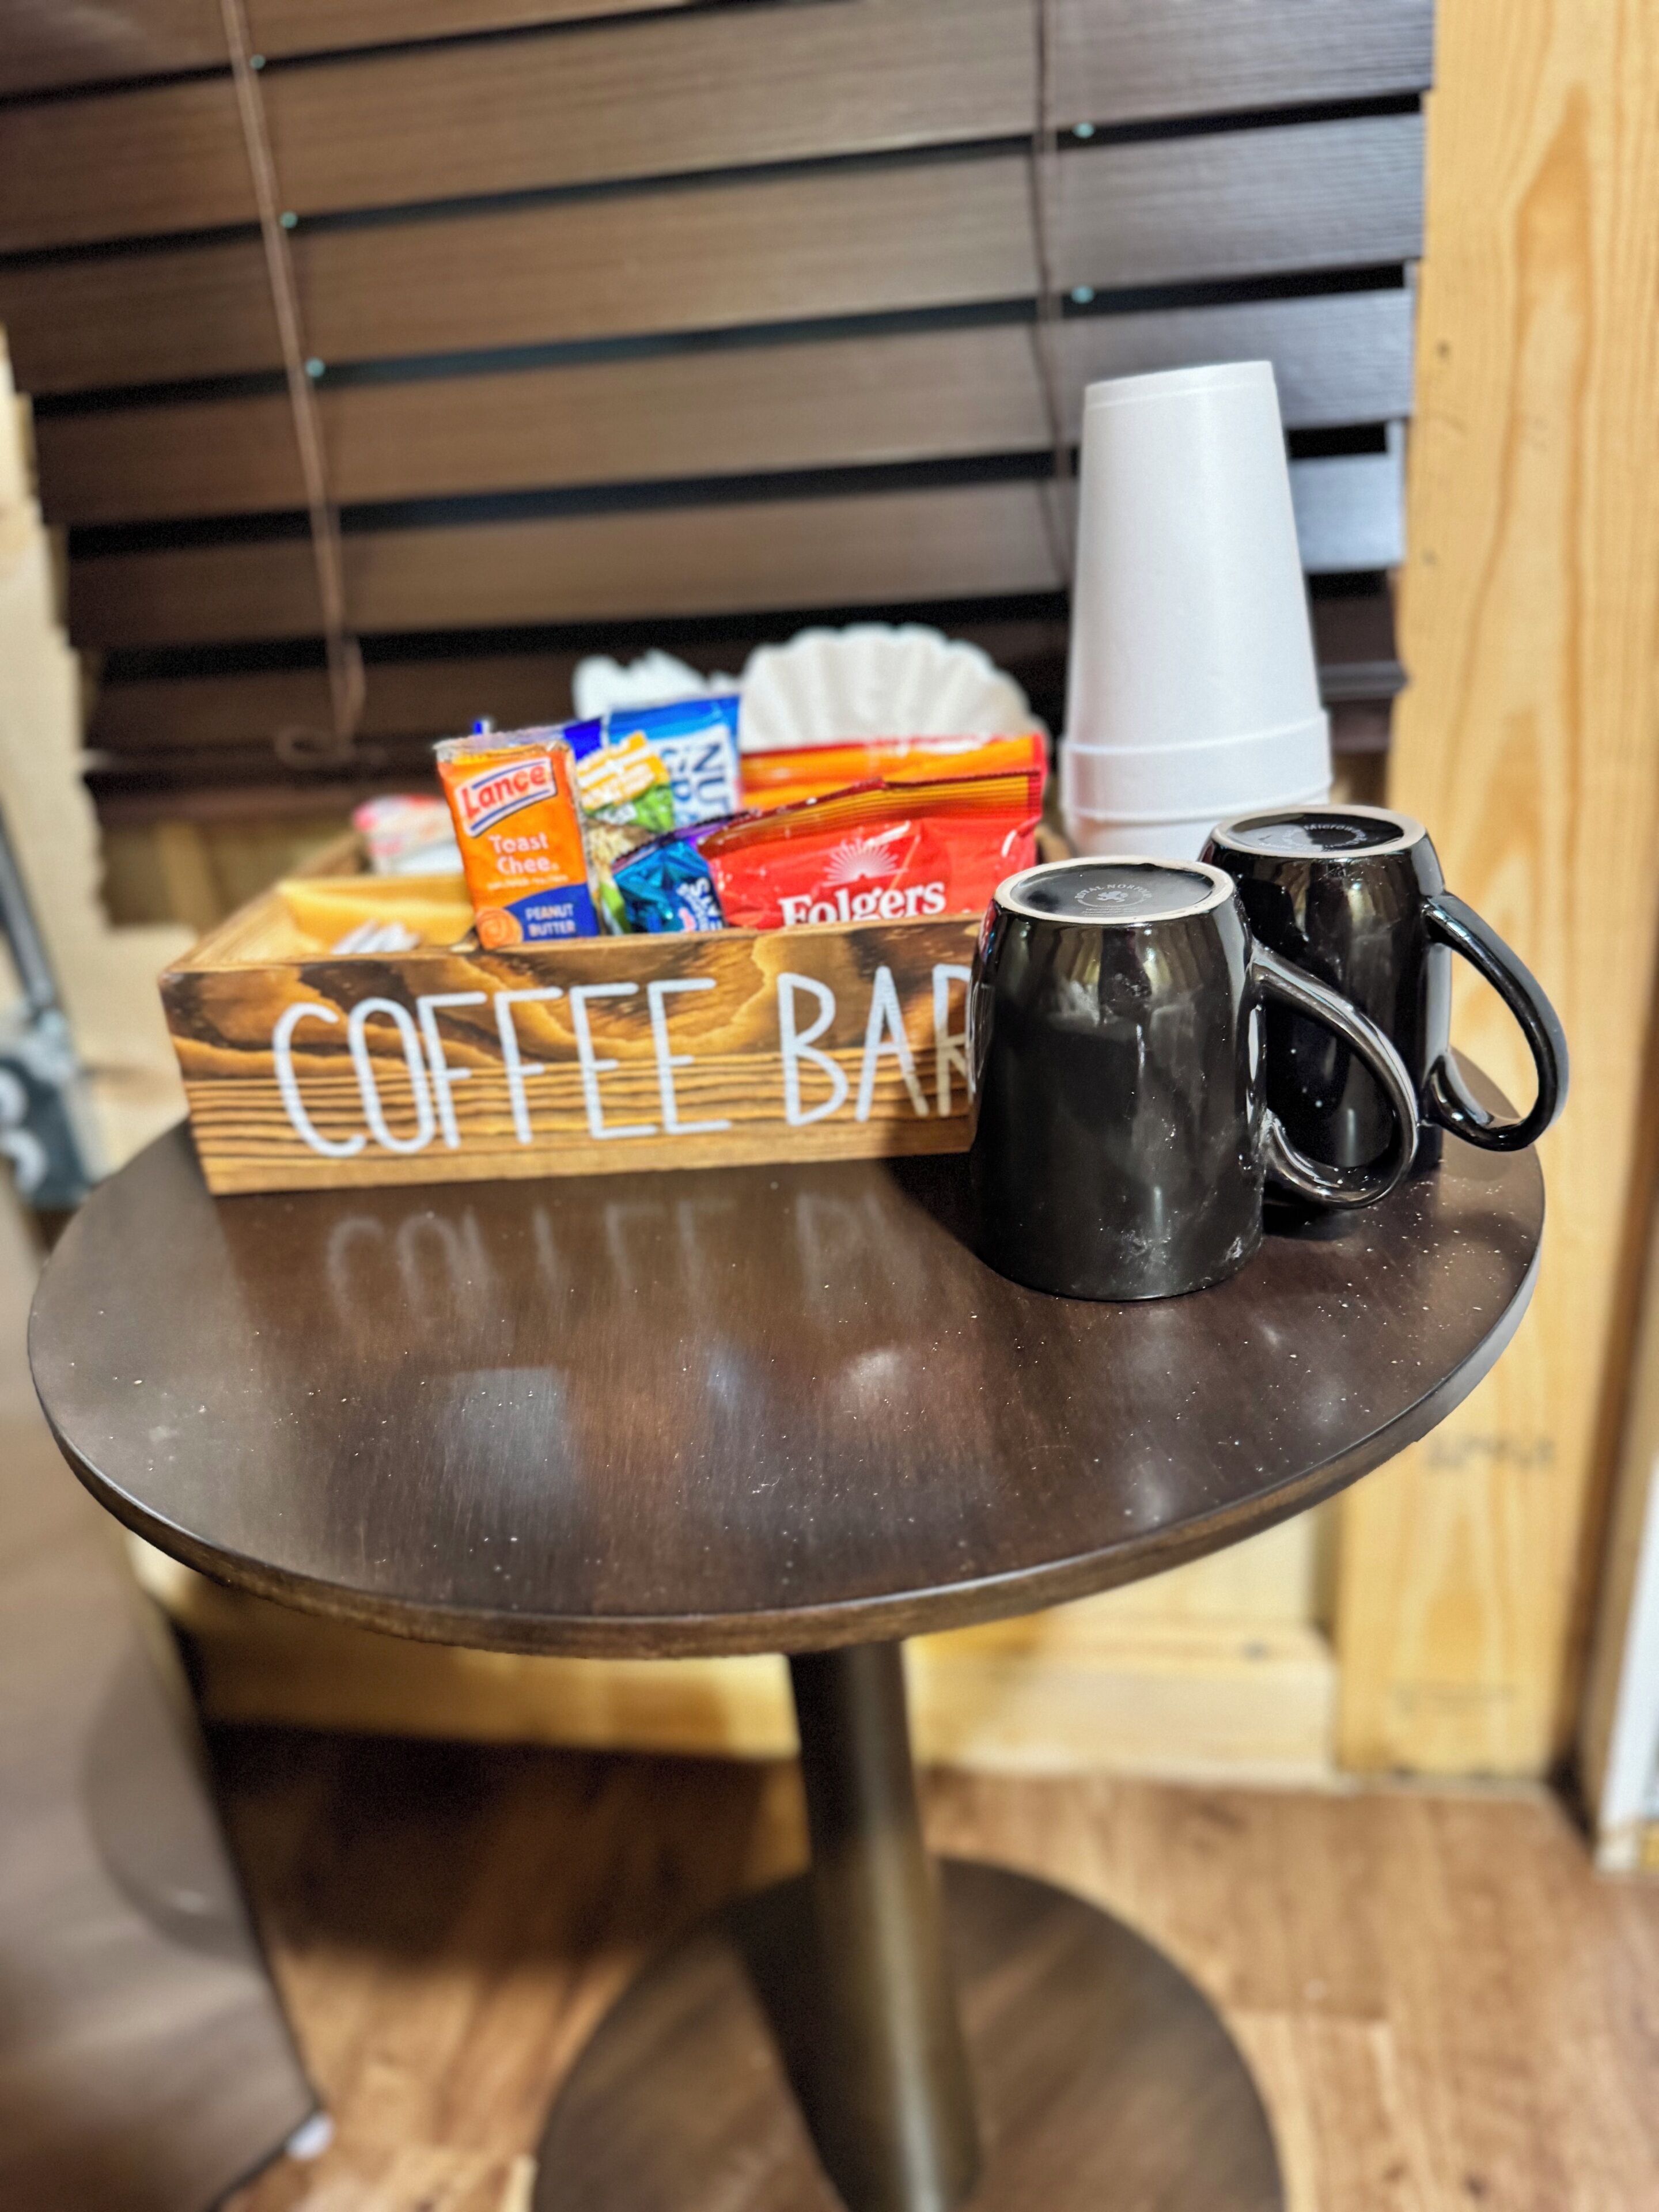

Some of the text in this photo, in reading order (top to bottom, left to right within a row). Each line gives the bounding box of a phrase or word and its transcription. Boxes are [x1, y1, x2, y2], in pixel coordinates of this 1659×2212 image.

[462, 765, 546, 819] Lance
[488, 832, 549, 854] Toast
[497, 855, 551, 876] Chee
[525, 903, 574, 921] PEANUT
[778, 881, 946, 926] Folgers
[528, 920, 575, 938] BUTTER
[272, 963, 972, 1157] COFFEE BAR
